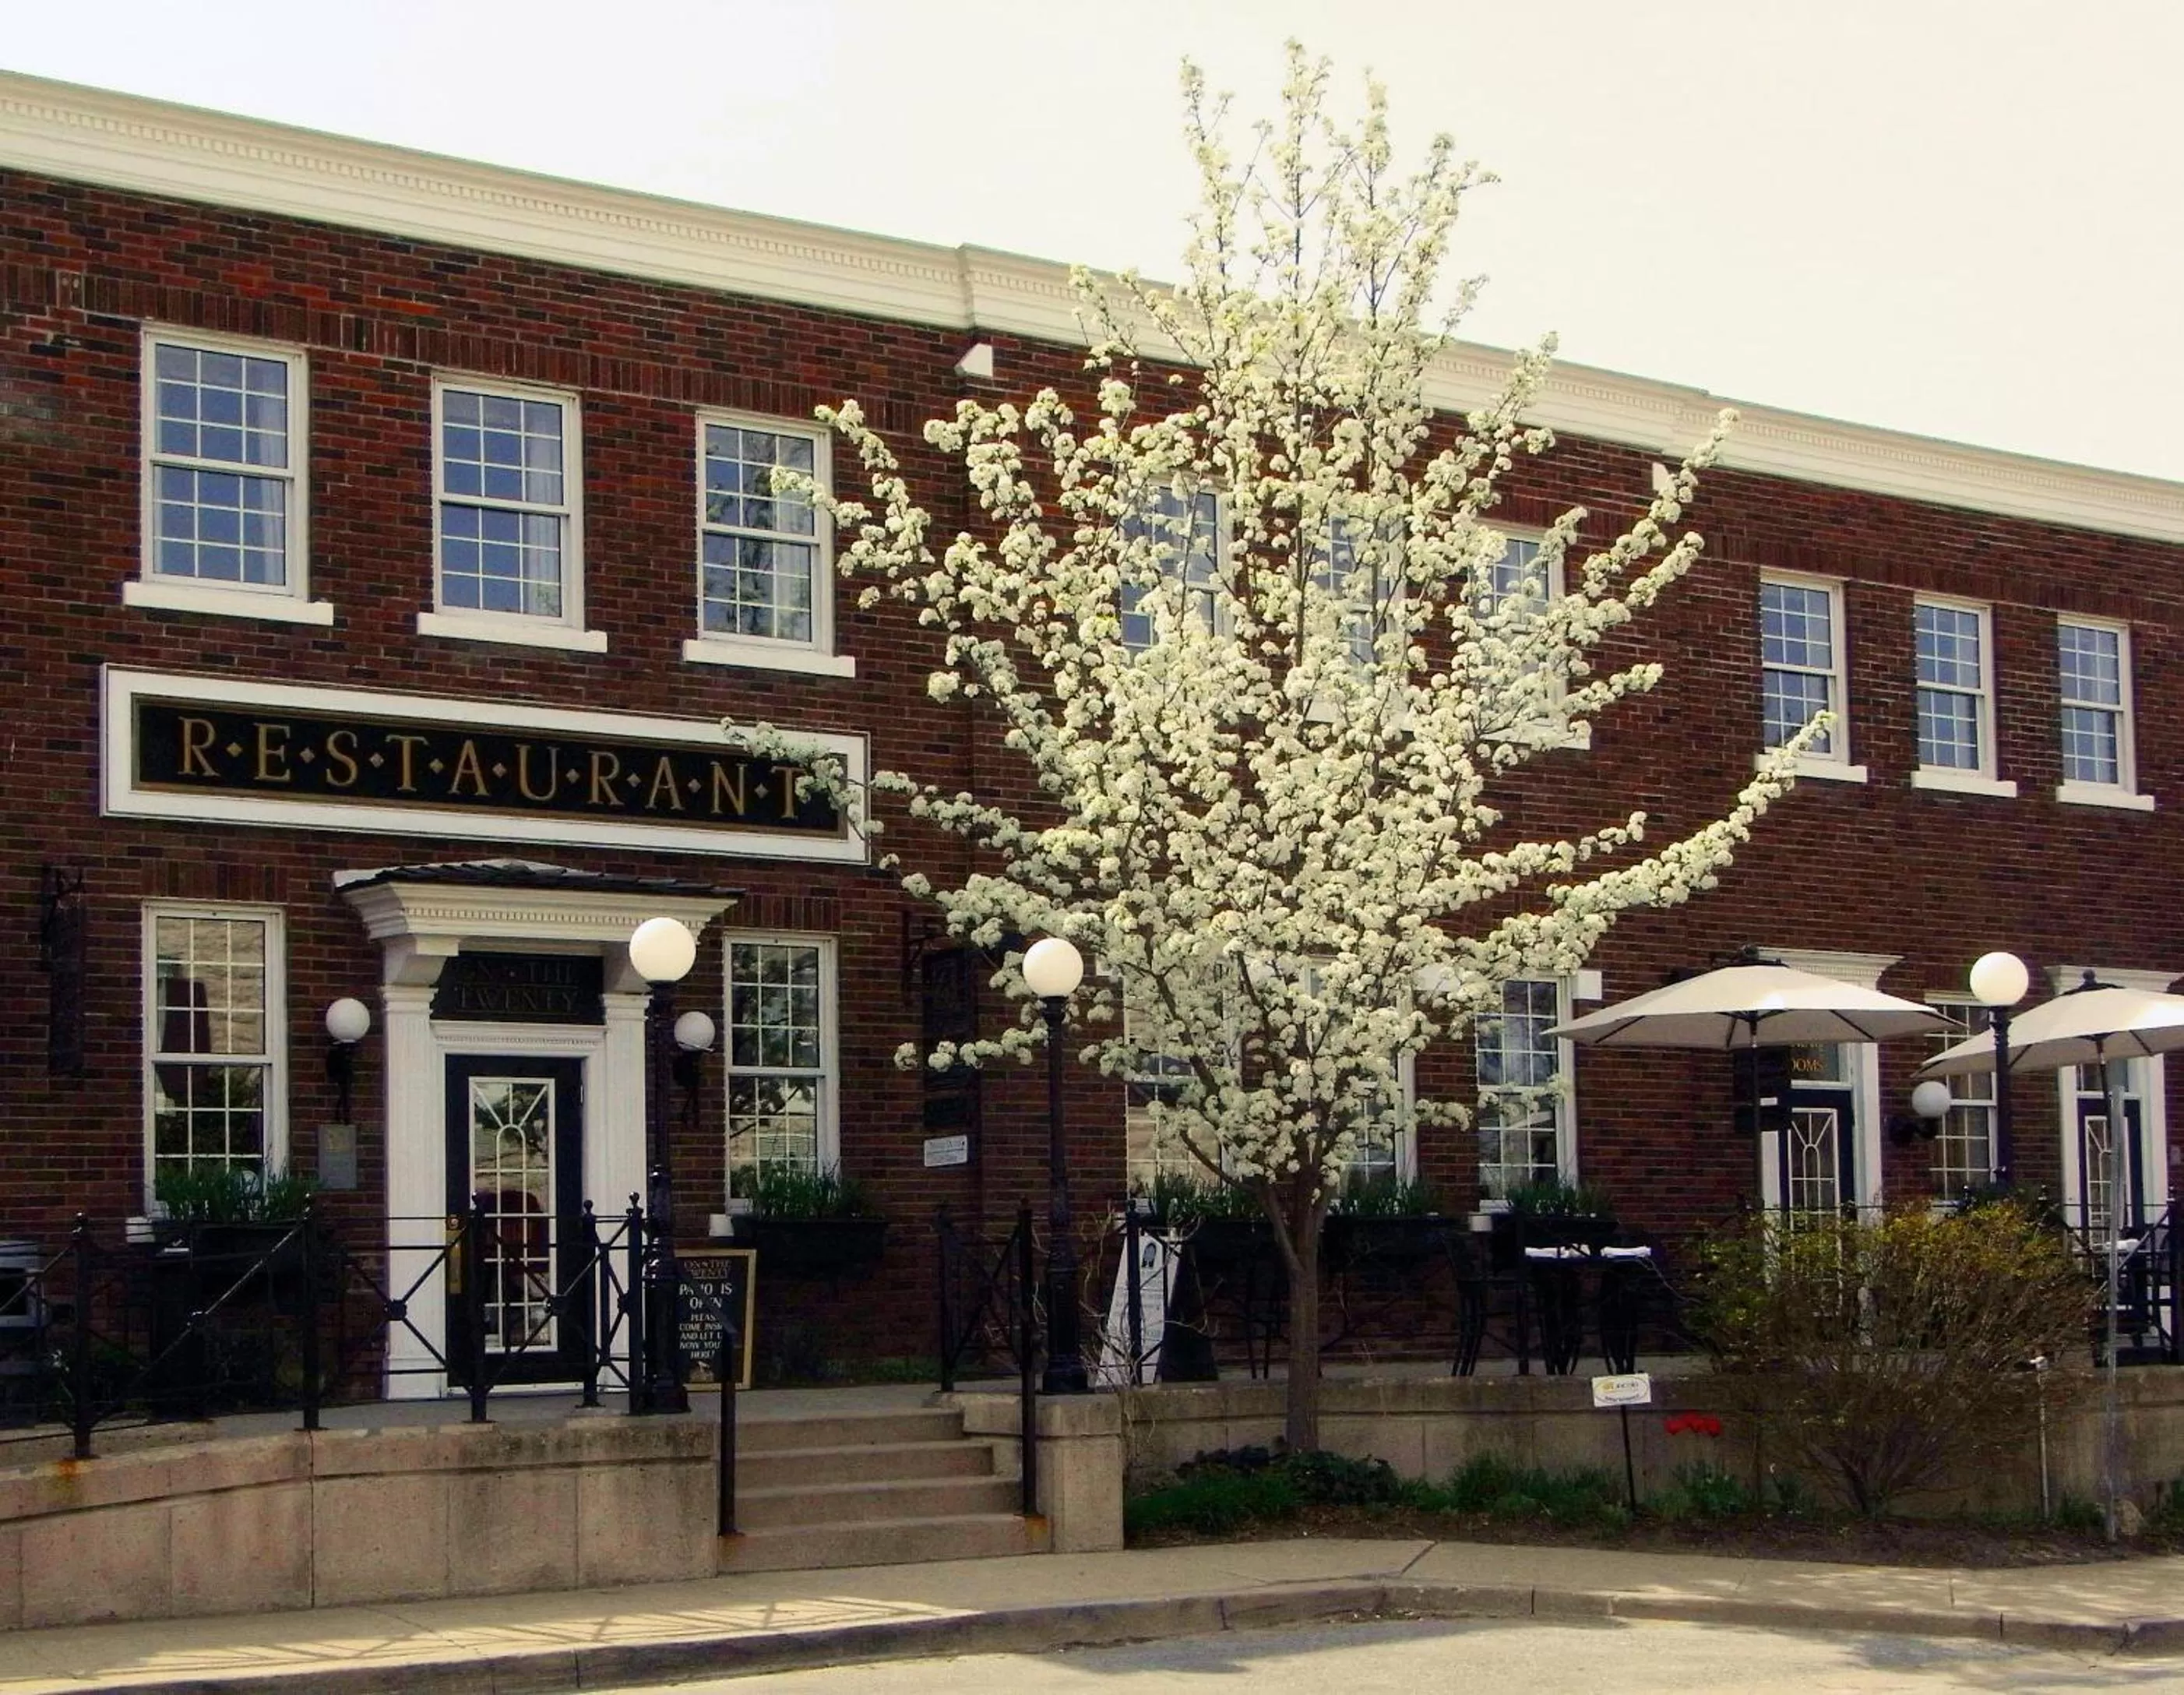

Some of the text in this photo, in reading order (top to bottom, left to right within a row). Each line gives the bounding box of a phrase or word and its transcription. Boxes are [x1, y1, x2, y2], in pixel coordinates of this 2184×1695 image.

[454, 987, 579, 1012] TWENTY
[679, 1282, 733, 1295] PAO IS
[690, 1313, 717, 1322] PLEAS
